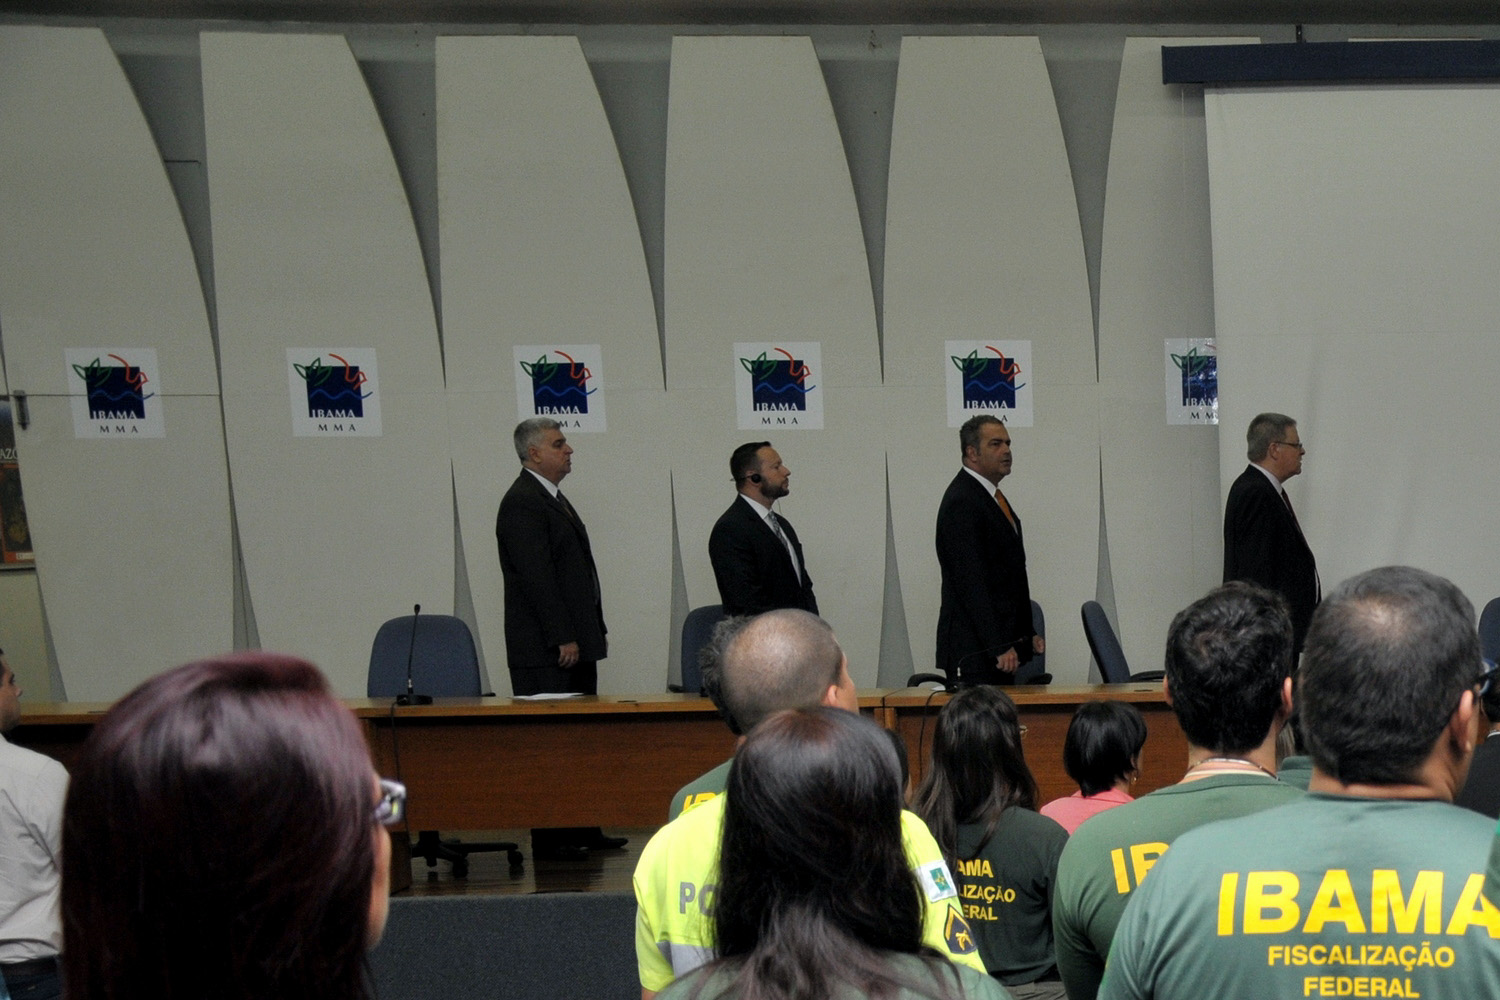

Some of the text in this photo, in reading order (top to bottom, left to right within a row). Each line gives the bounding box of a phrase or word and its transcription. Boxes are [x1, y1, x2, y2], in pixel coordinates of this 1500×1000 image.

[756, 402, 798, 411] IBAMA
[965, 400, 1008, 409] IBAMA
[1186, 397, 1219, 407] IBAM
[311, 409, 355, 418] IBAMA
[537, 405, 580, 414] IBAMA
[92, 410, 137, 420] IBAMA
[957, 858, 994, 878] AMA
[959, 884, 1016, 904] LIZAÇÃO
[963, 904, 998, 921] ERAL
[1267, 941, 1455, 972] FISCALIZAÇÃO
[1304, 976, 1420, 999] FEDERAL
